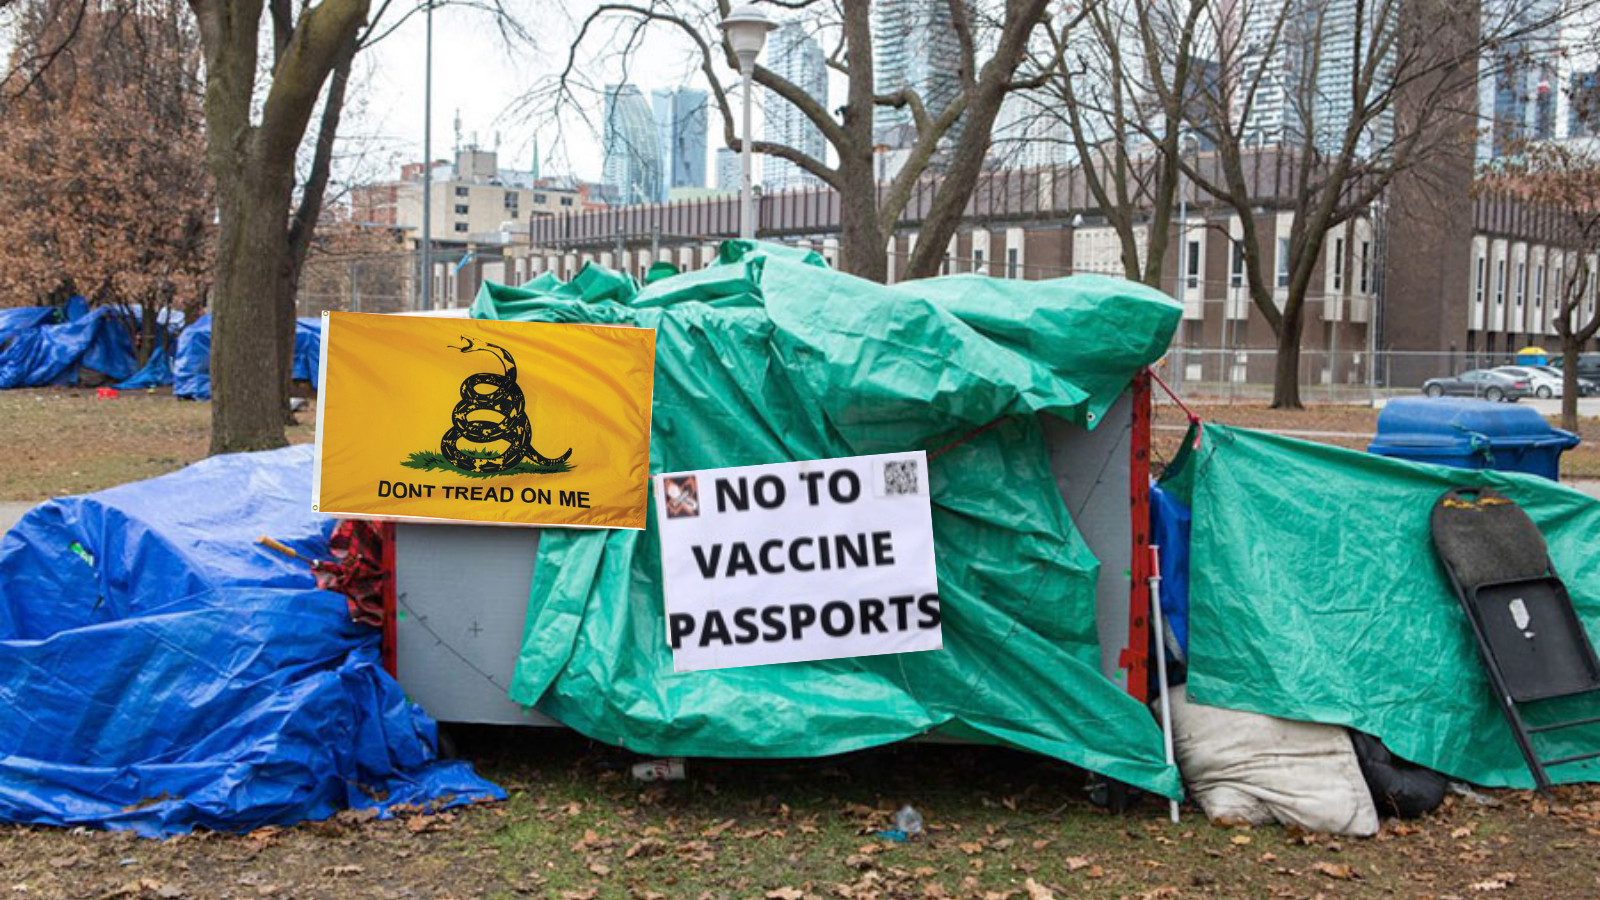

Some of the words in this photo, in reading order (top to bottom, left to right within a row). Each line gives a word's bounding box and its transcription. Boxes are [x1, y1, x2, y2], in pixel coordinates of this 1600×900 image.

[378, 480, 436, 498] DONT
[442, 485, 514, 503] TREAD
[520, 487, 552, 505] ON
[559, 490, 591, 508] ME
[715, 474, 786, 513] NO
[799, 469, 861, 506] TO
[691, 530, 895, 579] VACCINE
[669, 593, 941, 649] PASSPORTS
